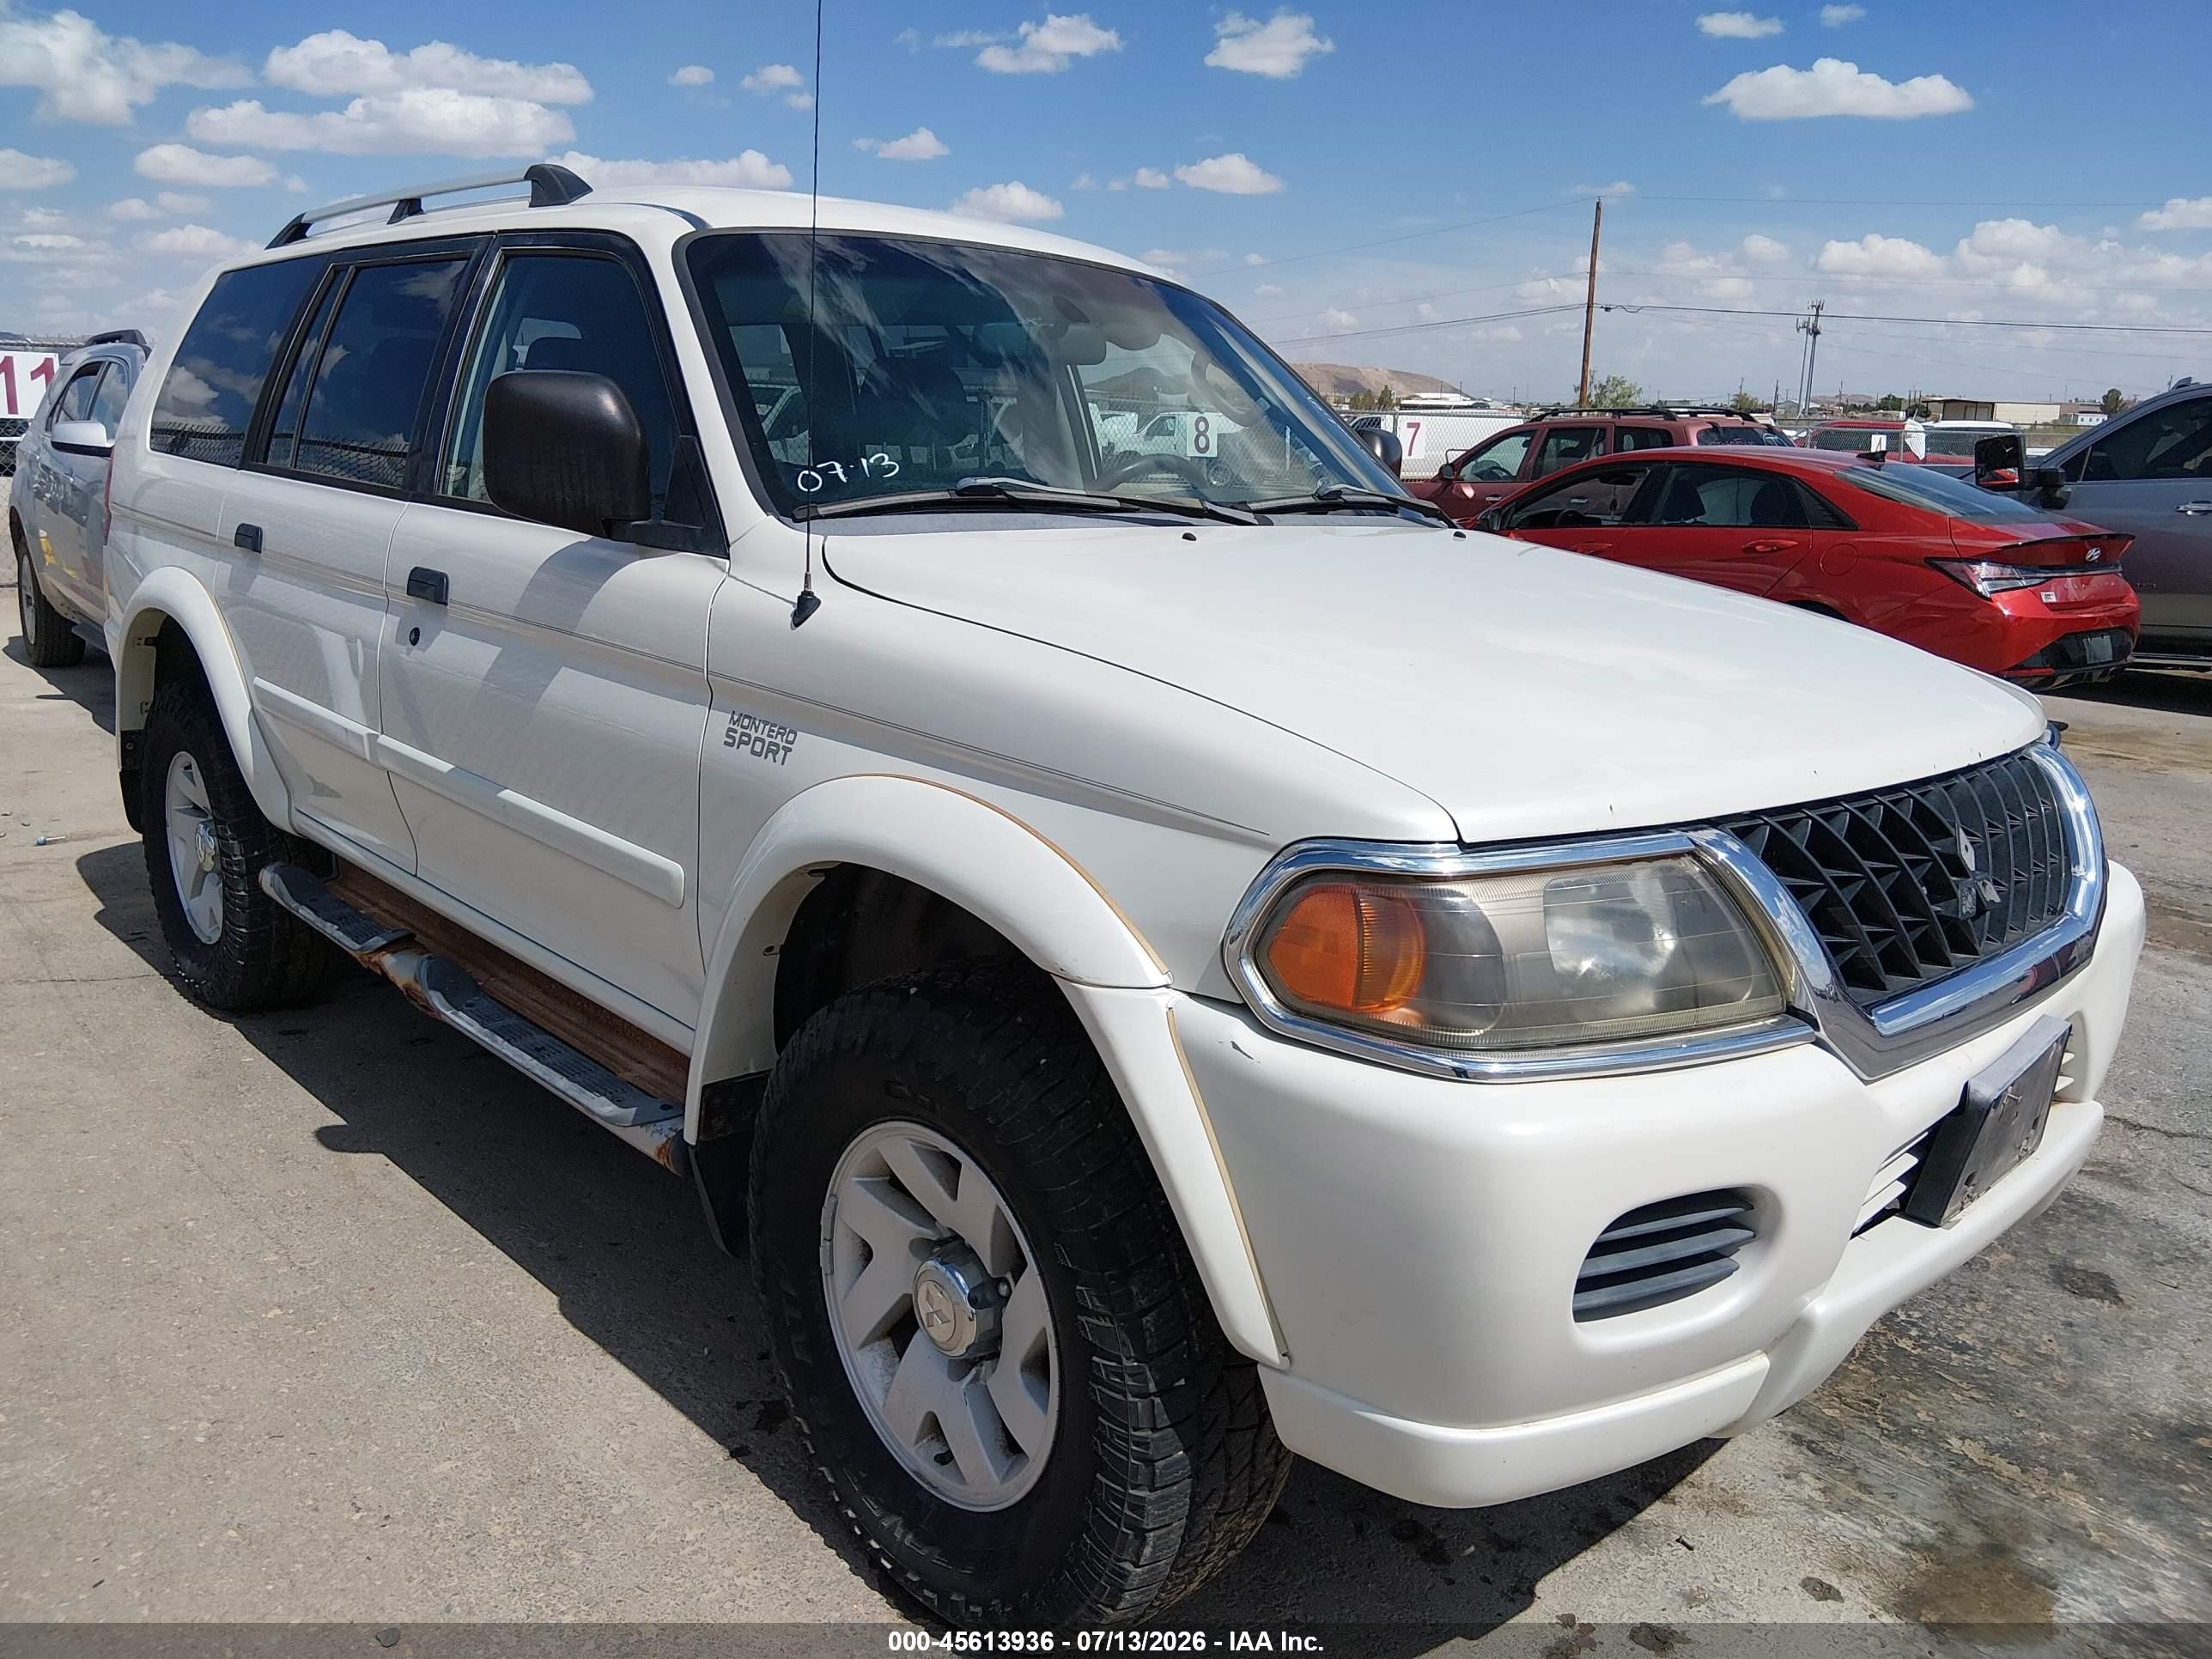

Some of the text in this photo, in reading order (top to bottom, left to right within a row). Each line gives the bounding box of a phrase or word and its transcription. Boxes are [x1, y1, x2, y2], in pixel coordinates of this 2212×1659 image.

[1194, 416, 1210, 454] 8
[1407, 422, 1421, 457] 7
[728, 710, 798, 745] MONTERO
[723, 726, 793, 766] SPORT
